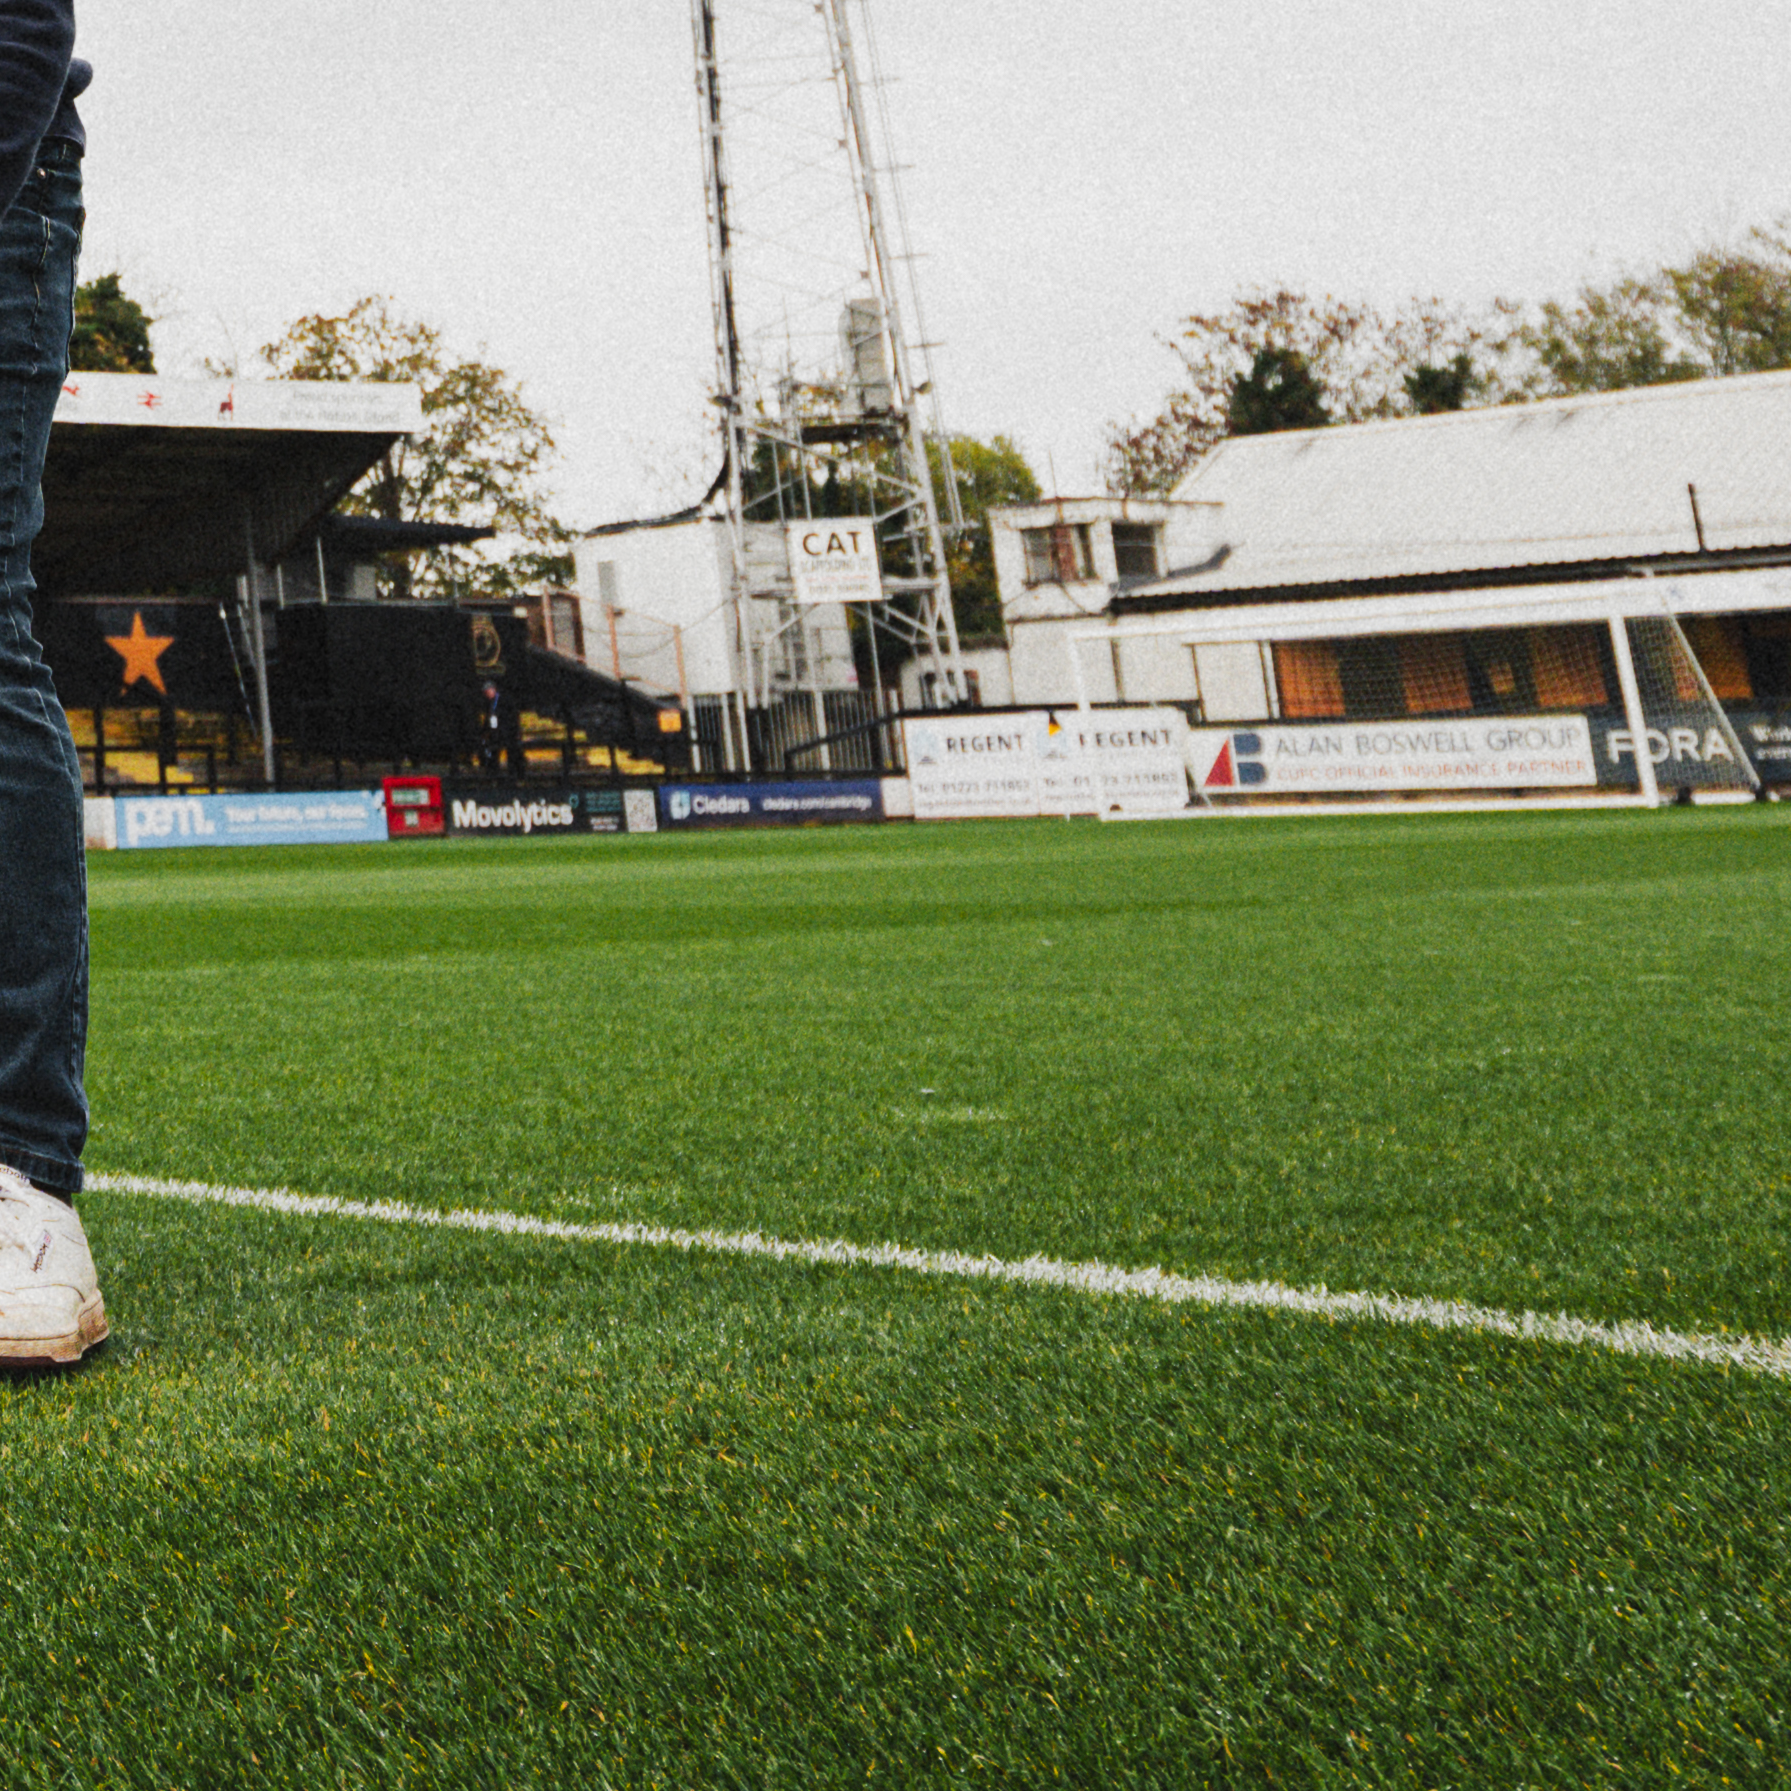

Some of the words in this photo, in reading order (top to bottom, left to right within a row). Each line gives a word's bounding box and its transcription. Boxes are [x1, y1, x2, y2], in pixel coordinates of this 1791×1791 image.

[802, 530, 862, 556] CAT
[946, 733, 1024, 753] REGENT
[1275, 734, 1343, 759] ALAN
[1355, 731, 1472, 757] BOSWELL
[1485, 727, 1582, 753] GROUP
[1605, 727, 1735, 764] FORA
[1276, 764, 1319, 782] CUFC
[1324, 763, 1397, 781] OFFICIAL
[1402, 761, 1498, 779] INSURANCE
[1506, 758, 1586, 775] PARTNER
[452, 798, 574, 834] Movolytics
